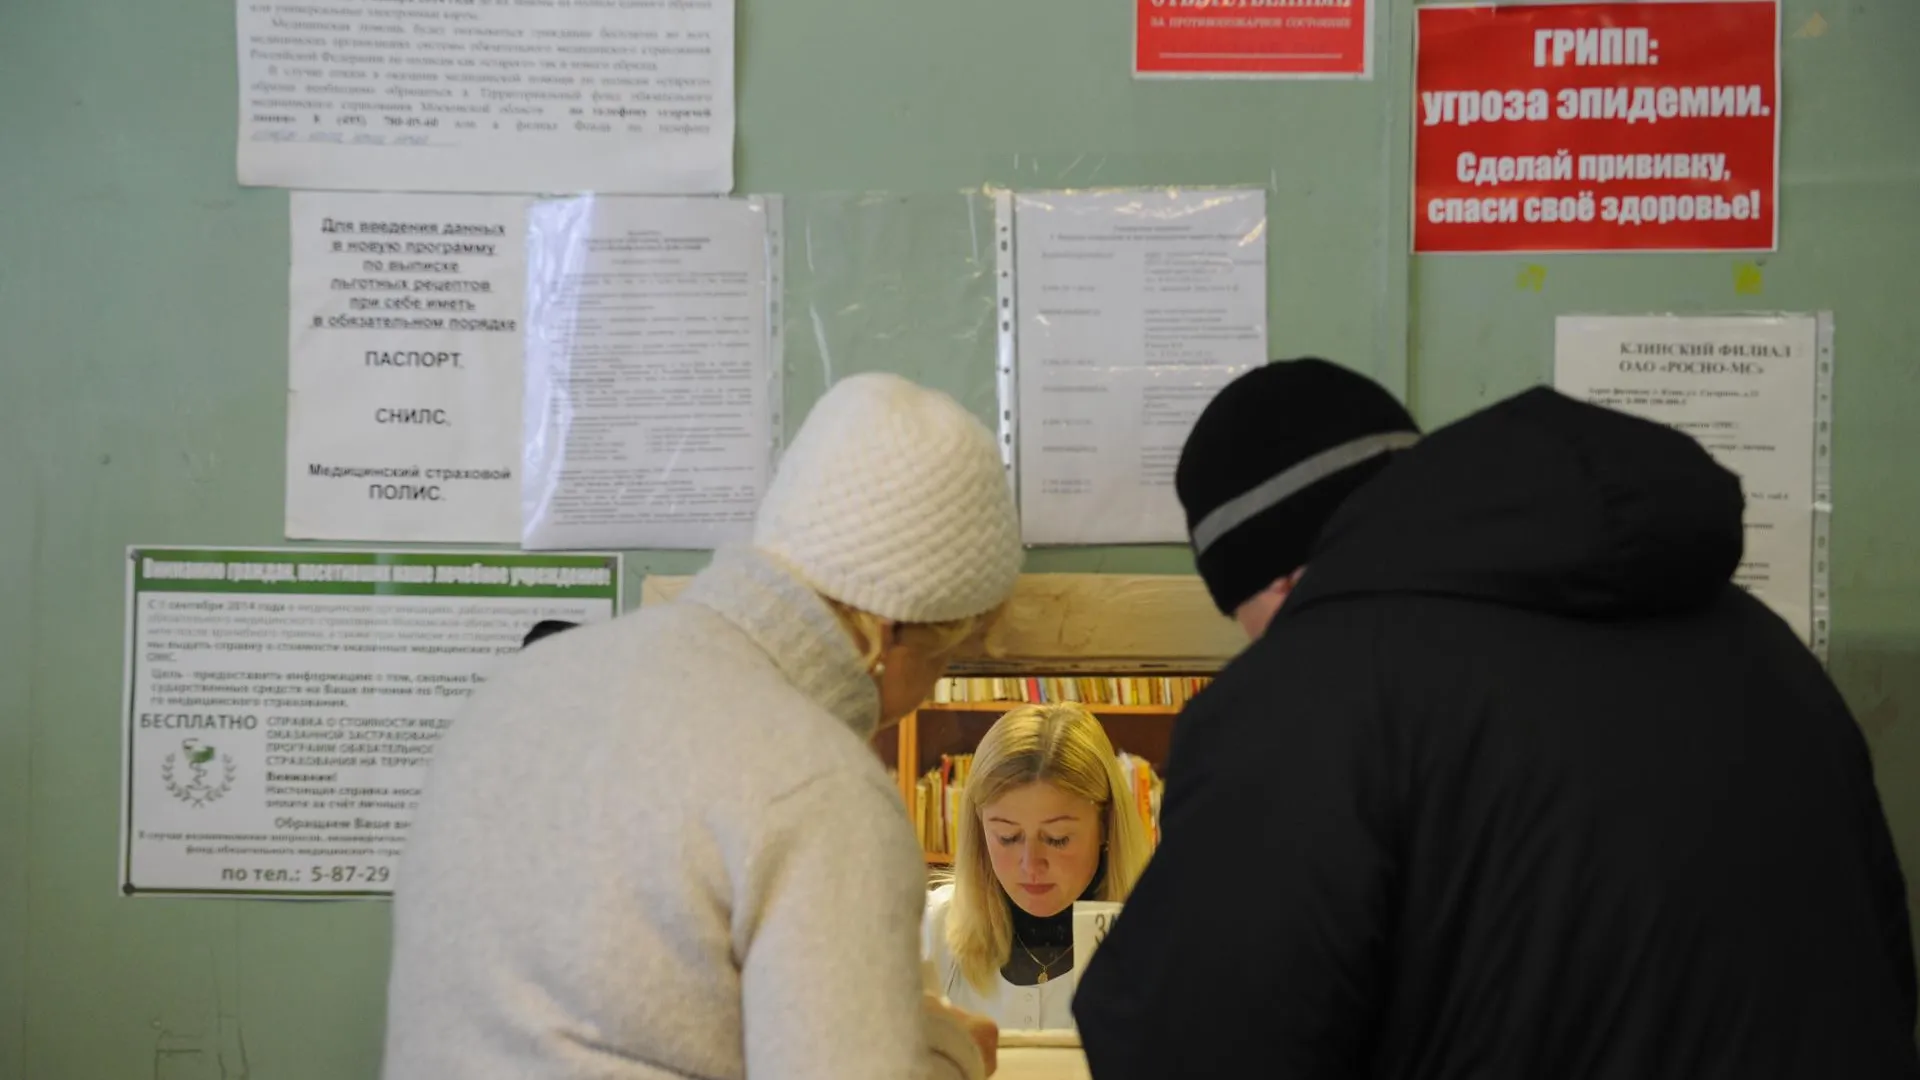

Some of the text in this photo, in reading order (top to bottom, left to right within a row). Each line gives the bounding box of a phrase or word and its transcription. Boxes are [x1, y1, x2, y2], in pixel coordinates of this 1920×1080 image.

[1534, 27, 1659, 68] ГРИПП:
[1422, 85, 1771, 126] угроза эпидемии.
[1456, 149, 1731, 185] Сделай прививку,
[1427, 189, 1762, 225] спаси своё здоровье!
[321, 218, 506, 236] Для введения данных
[347, 242, 401, 255] новую
[405, 242, 496, 256] программу
[362, 260, 460, 273] по выписке
[330, 278, 492, 293] льготных рецептов
[349, 295, 477, 312] при себе иметь
[327, 313, 445, 329] обязательном
[449, 317, 518, 331] порядке
[1619, 341, 1792, 358] КЛИНСКИЙ ФИЛИАЛ
[1618, 360, 1656, 374] ОАО
[308, 463, 513, 481] Медицинский страховой
[140, 713, 259, 731] БЕСПЛАТНО
[221, 865, 391, 882] по тел.: 5-87-29
